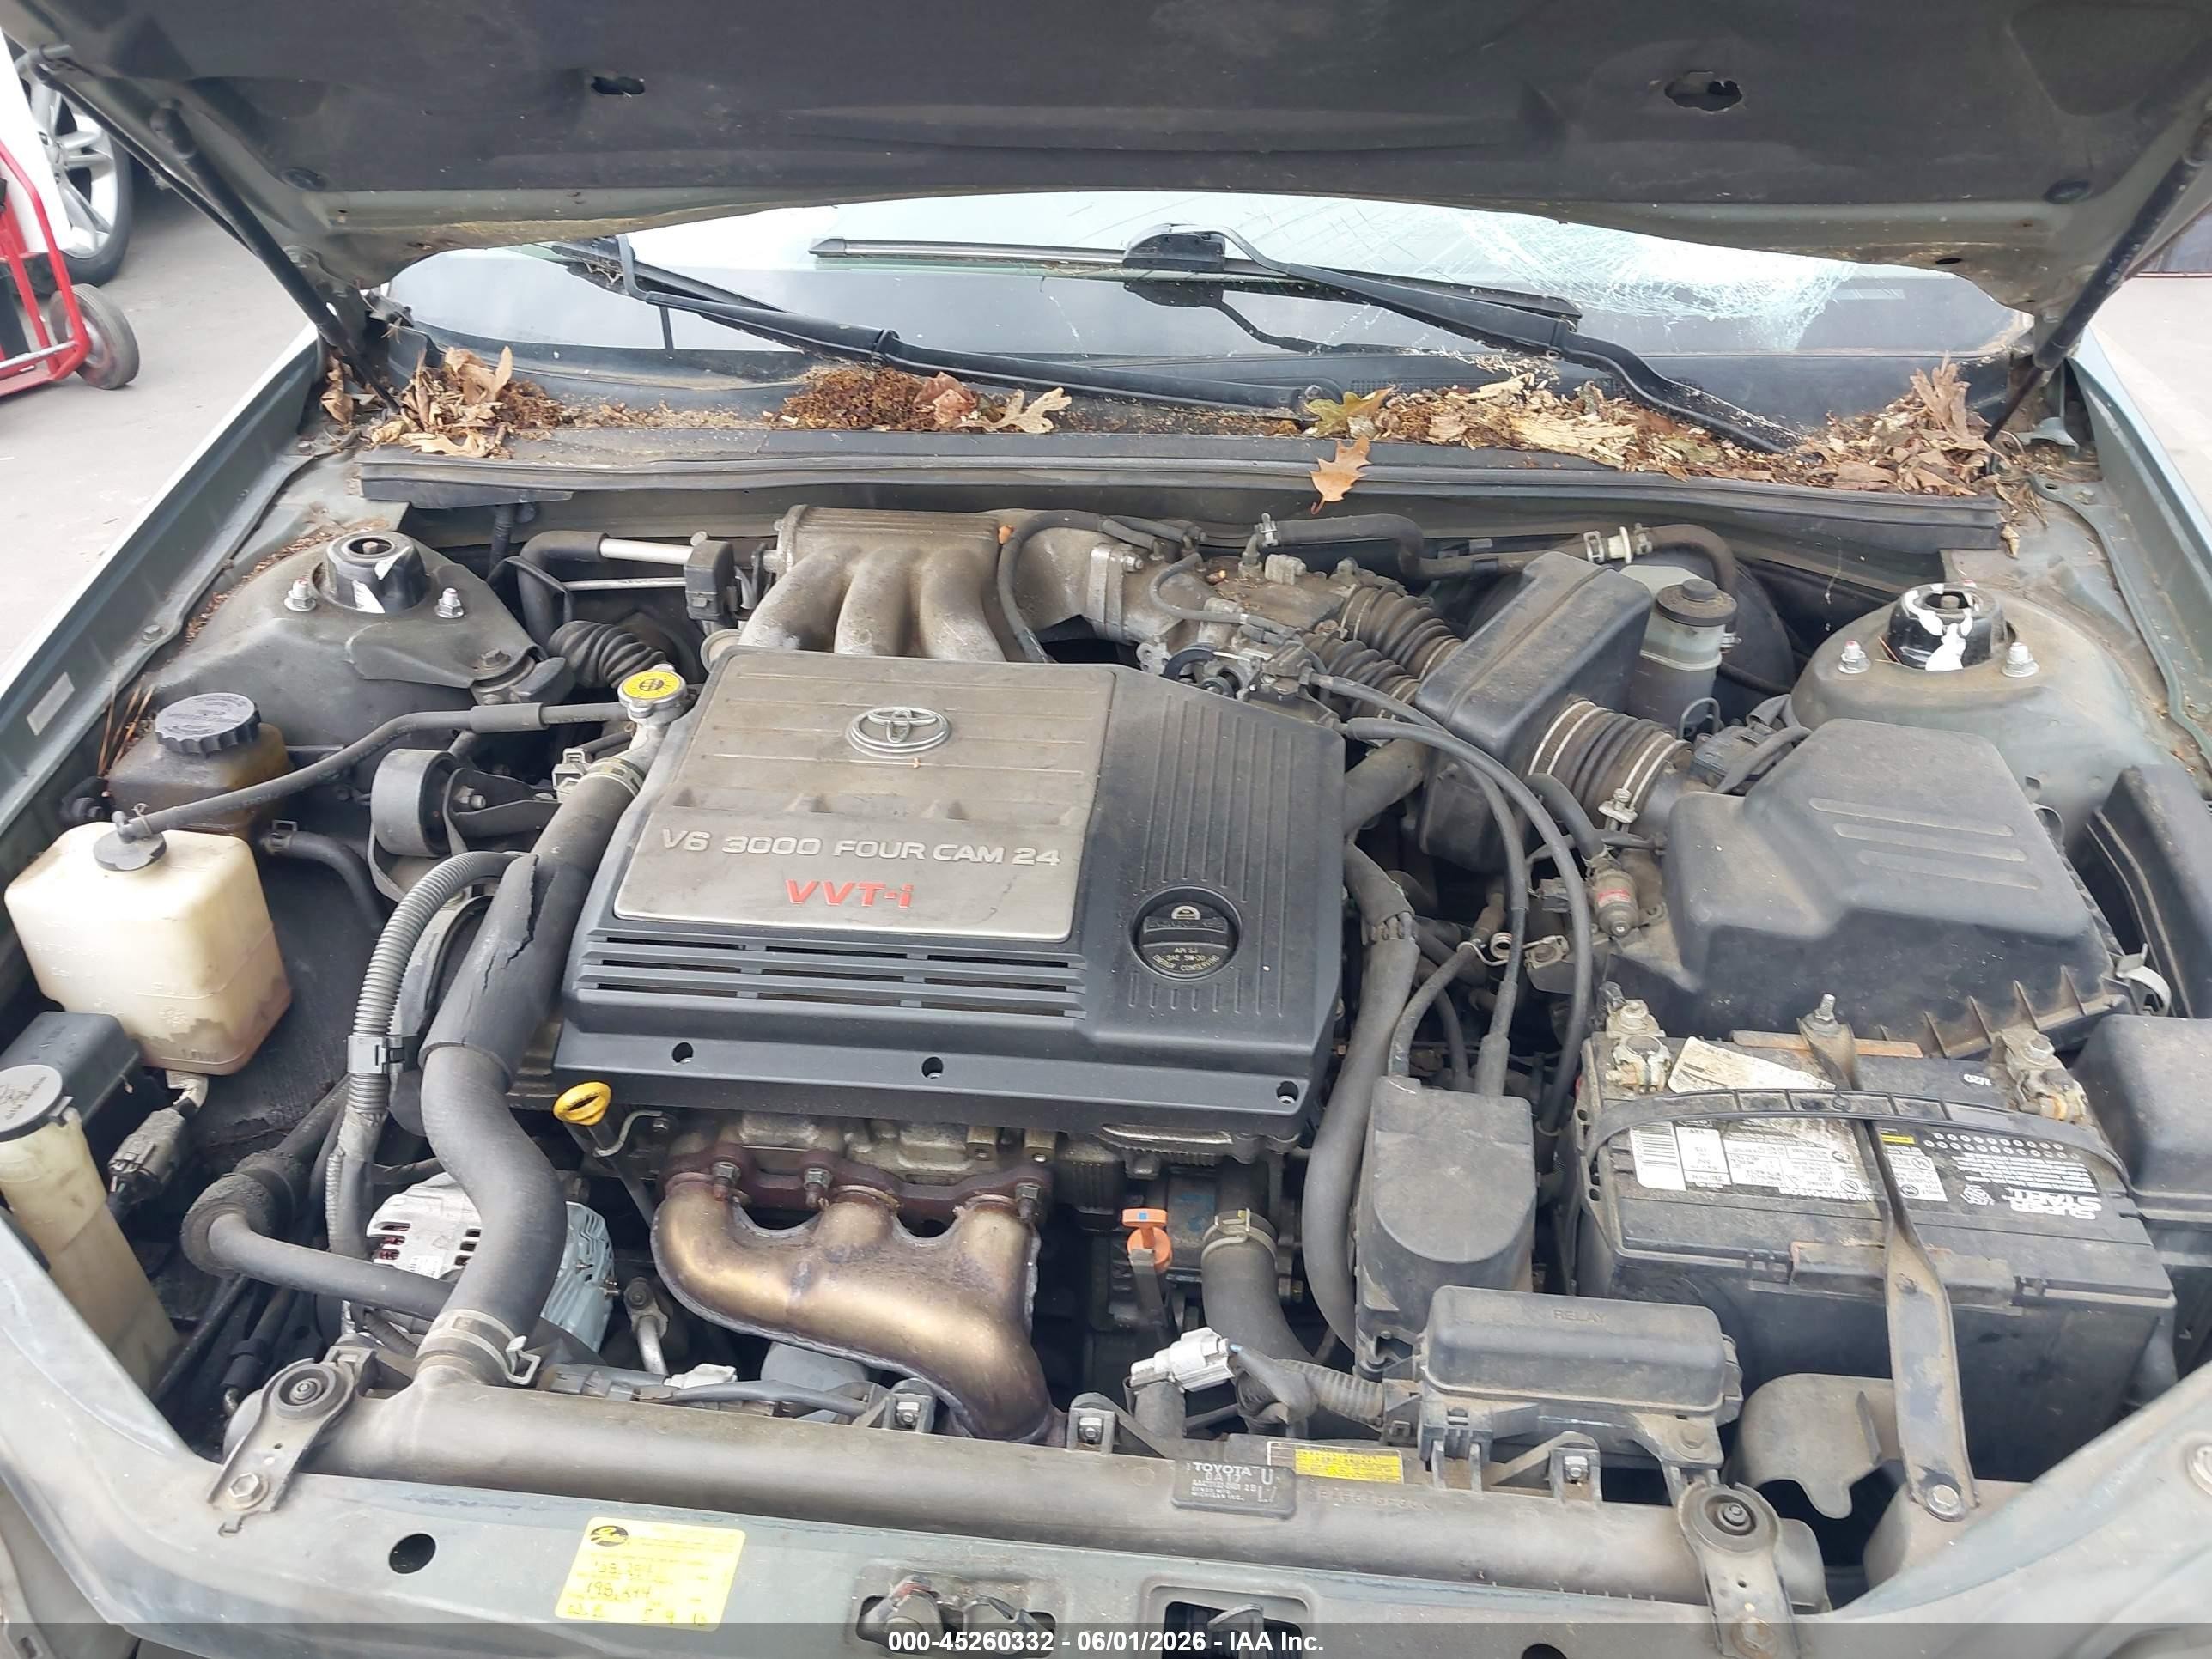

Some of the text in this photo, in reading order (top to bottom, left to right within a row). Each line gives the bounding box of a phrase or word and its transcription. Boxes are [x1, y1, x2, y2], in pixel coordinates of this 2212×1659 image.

[661, 828, 1061, 866] V6 3000 FOUR CAM 24
[785, 878, 915, 908] VVT-i
[1553, 1308, 1607, 1323] RELAY
[1193, 1462, 1253, 1477] TOYOTA
